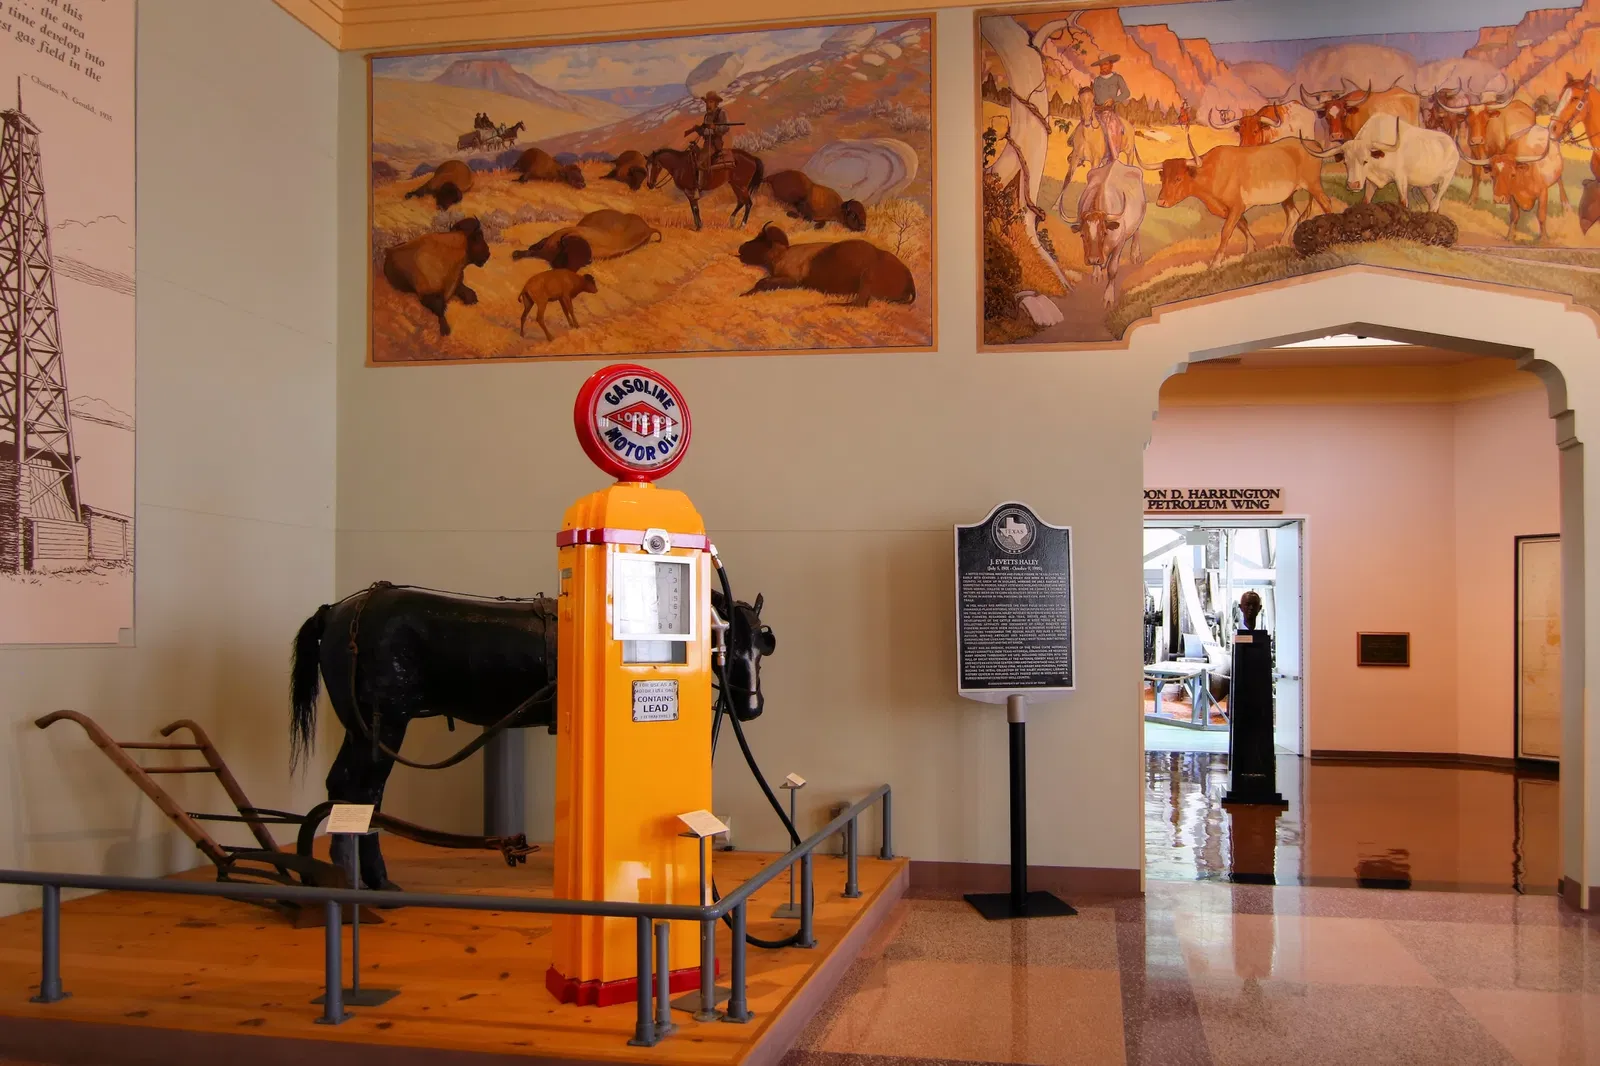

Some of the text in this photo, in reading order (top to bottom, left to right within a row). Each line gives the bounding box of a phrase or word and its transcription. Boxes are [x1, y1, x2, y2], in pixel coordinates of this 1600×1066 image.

[40, 7, 85, 39] the area
[62, 3, 83, 21] this
[8, 6, 105, 68] time develop into
[0, 20, 102, 82] st gas field in the
[30, 75, 59, 94] Charles
[604, 378, 675, 410] GASOLINE
[604, 426, 679, 461] MOTOR OIL
[1147, 499, 1270, 510] PETROLEUM WING
[1171, 489, 1184, 500] D.
[1188, 488, 1280, 499] HARRINGTON
[643, 704, 669, 712] LEAD
